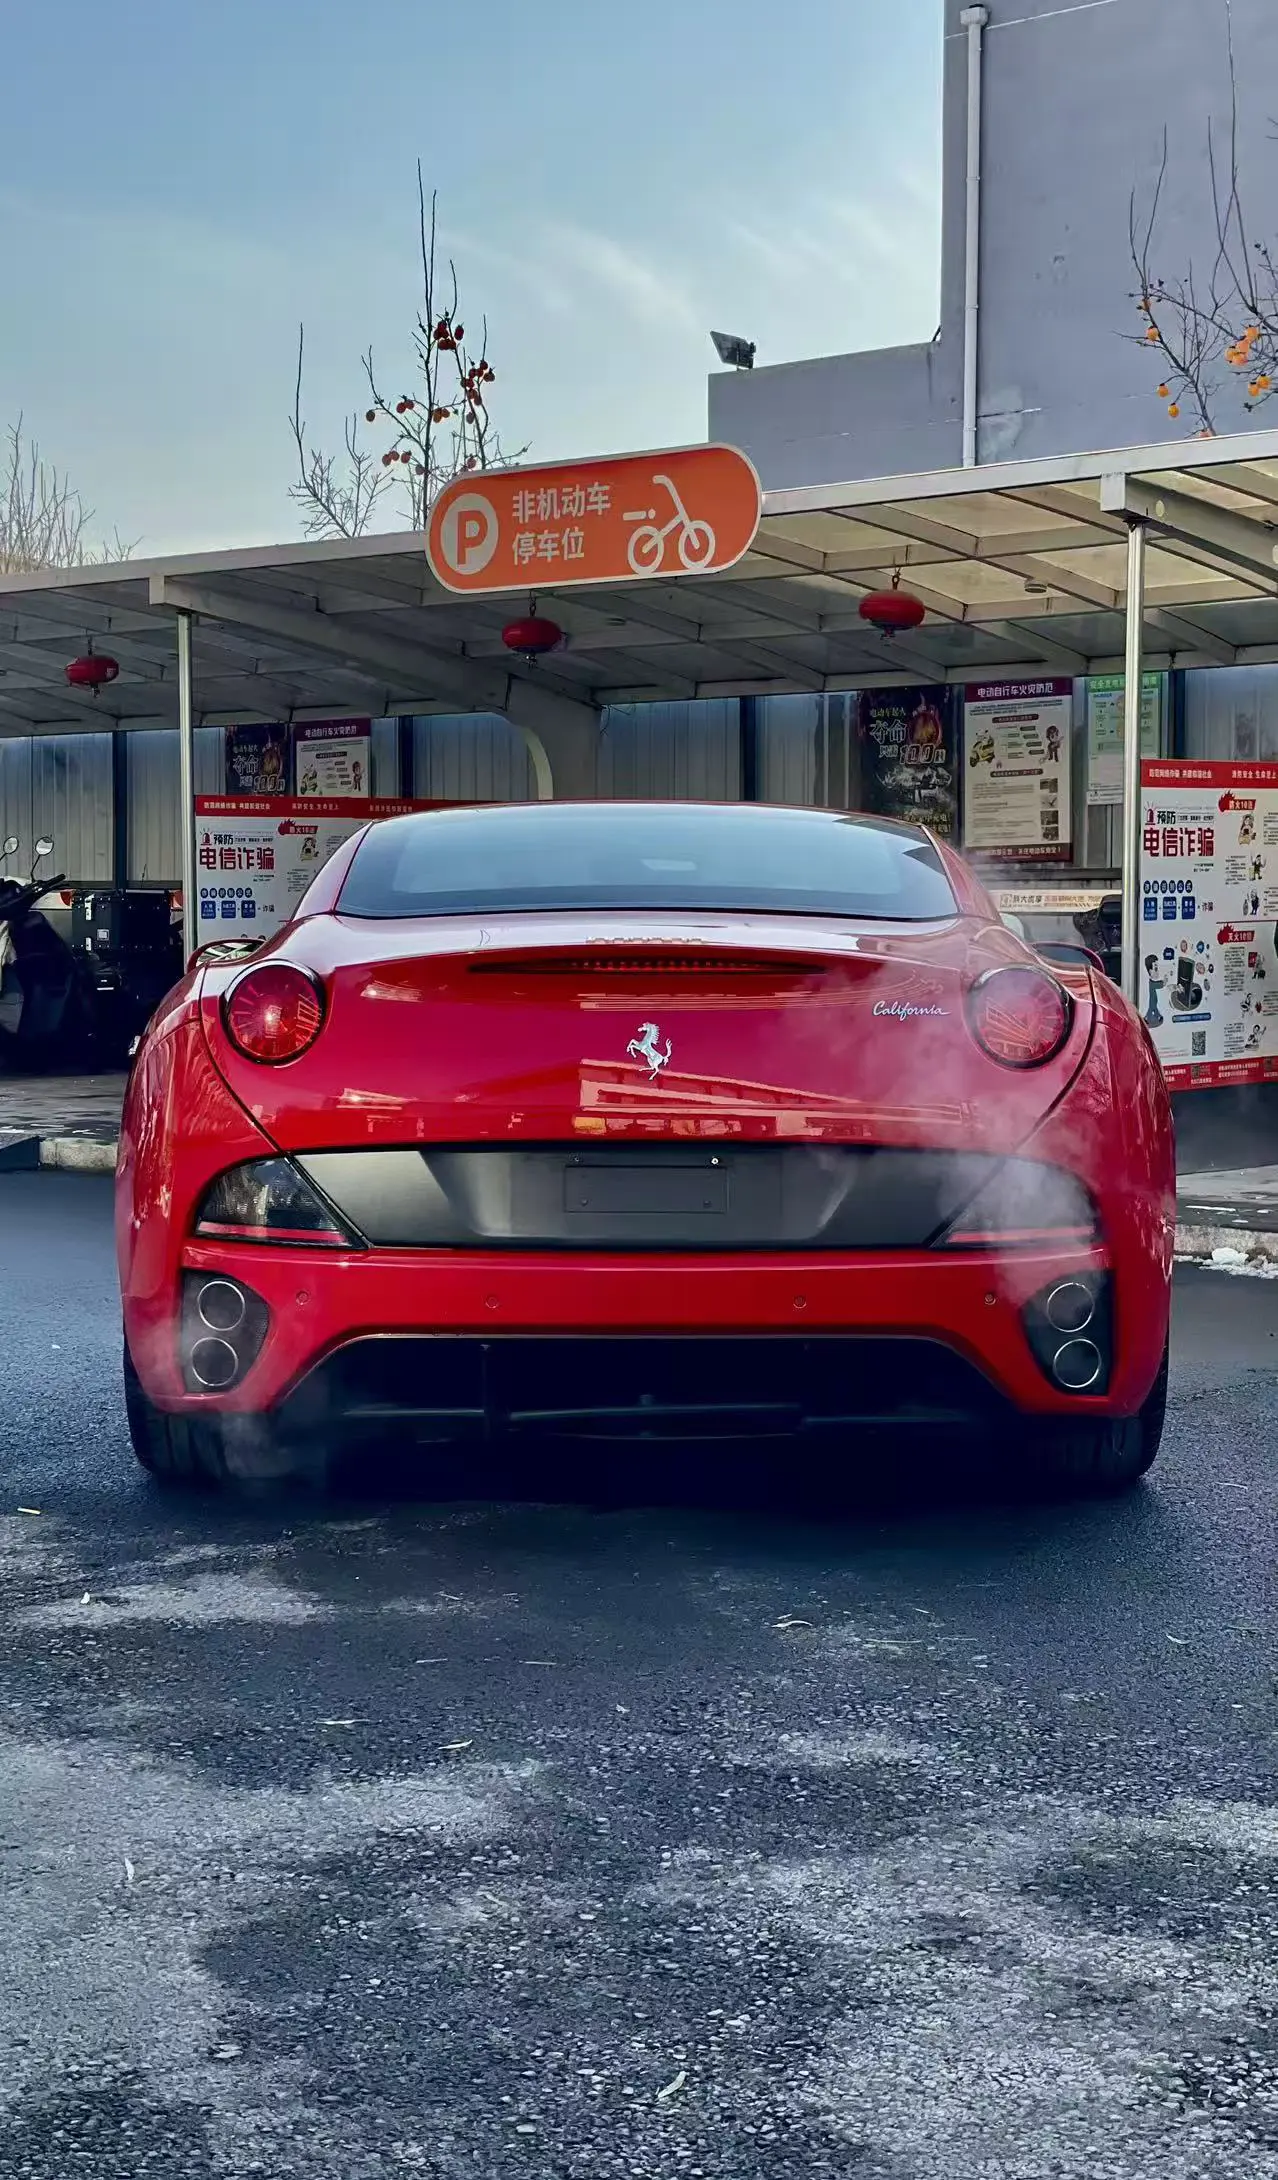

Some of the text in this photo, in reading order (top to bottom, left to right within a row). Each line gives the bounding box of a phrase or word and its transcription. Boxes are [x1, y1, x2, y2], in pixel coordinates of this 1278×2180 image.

[512, 481, 612, 524] 非机动车
[456, 509, 488, 566] P
[512, 525, 585, 566] 停车位
[977, 682, 1053, 698] 电动自行车火灾防范
[868, 719, 907, 745] 夺命
[1157, 811, 1176, 825] 预防
[213, 833, 234, 845] 预防
[1143, 827, 1214, 857] 电信诈骗
[199, 846, 275, 870] 电信诈骗
[873, 1000, 952, 1022] California
